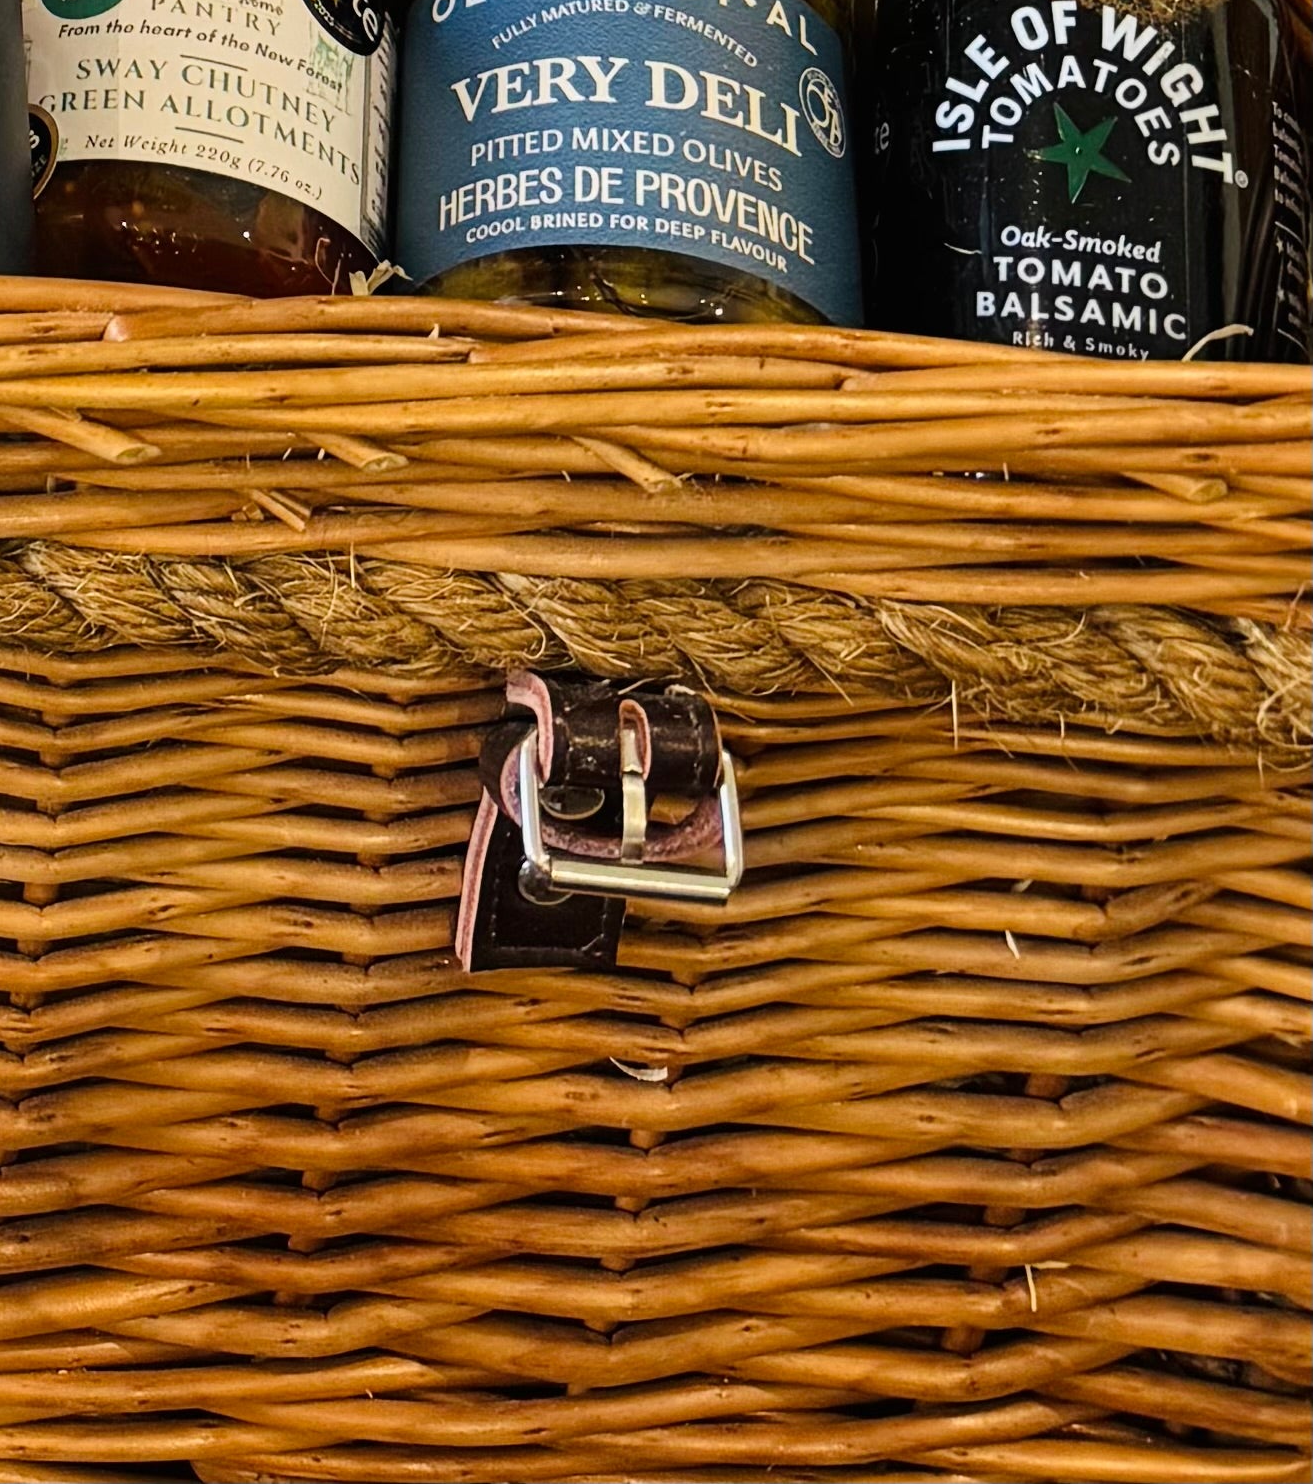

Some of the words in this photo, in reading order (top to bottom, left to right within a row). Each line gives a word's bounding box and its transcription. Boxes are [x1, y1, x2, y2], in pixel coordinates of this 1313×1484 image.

[76, 59, 169, 80] SWAY
[181, 64, 337, 134] CHUTNEY
[450, 55, 630, 124] VERY
[645, 60, 803, 157] DELI
[932, 34, 1010, 154] ISLE
[1010, 0, 1078, 51] OF
[1100, 5, 1235, 183] WIGHT
[981, 55, 1181, 168] TOMATOES
[38, 89, 145, 113] GREEN
[160, 92, 361, 187] ALLOTMENTS
[470, 129, 565, 166] PITTED
[572, 128, 675, 157] MIXED
[439, 167, 562, 231] HERBES
[574, 165, 623, 205] DE
[635, 170, 815, 265] PROVENCE
[1000, 225, 1162, 263] Oak-Smoked
[976, 290, 1187, 340] BALSAMIC
[993, 256, 1168, 300] TOMATO
